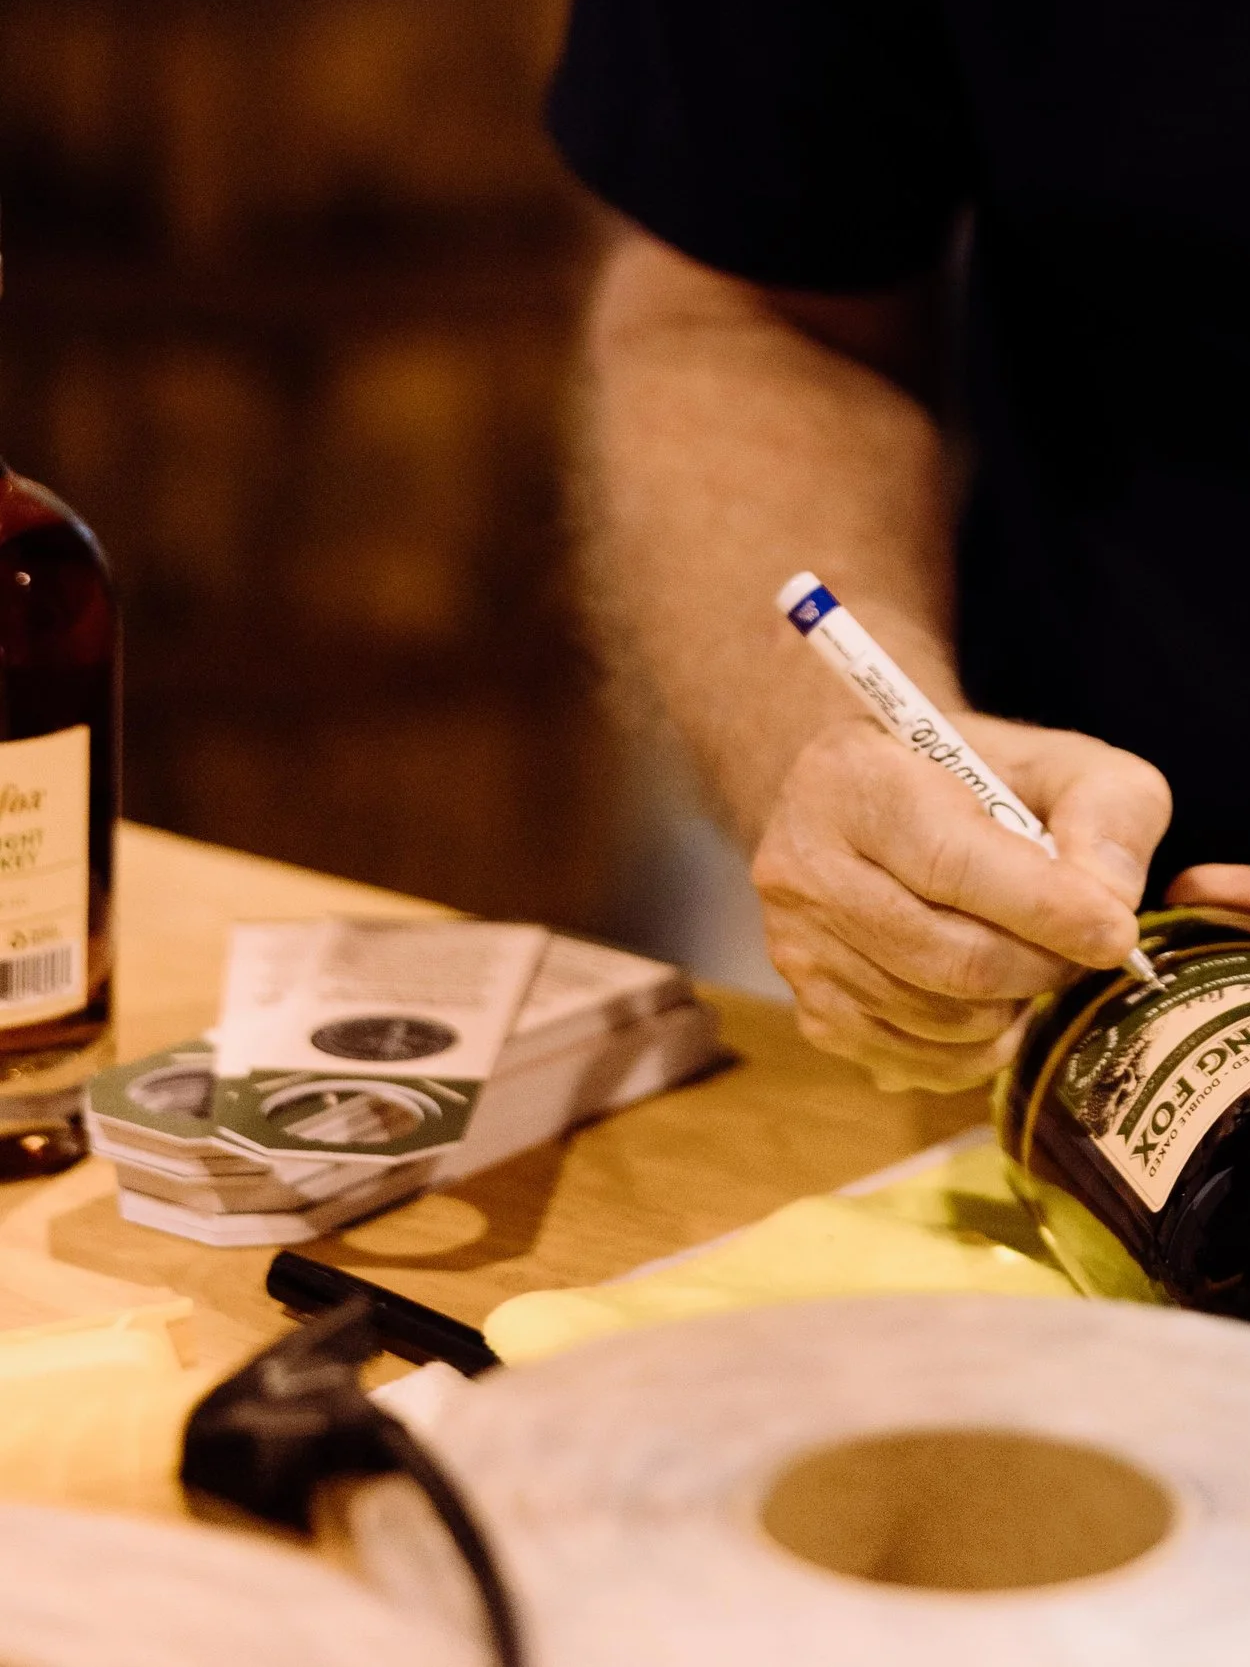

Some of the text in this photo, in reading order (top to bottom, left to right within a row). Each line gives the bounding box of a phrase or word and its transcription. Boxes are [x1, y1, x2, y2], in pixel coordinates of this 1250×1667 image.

[1132, 1075, 1197, 1167] FOX
[1178, 1077, 1221, 1126] DOUBLE
[1147, 1128, 1178, 1178] OAKED
